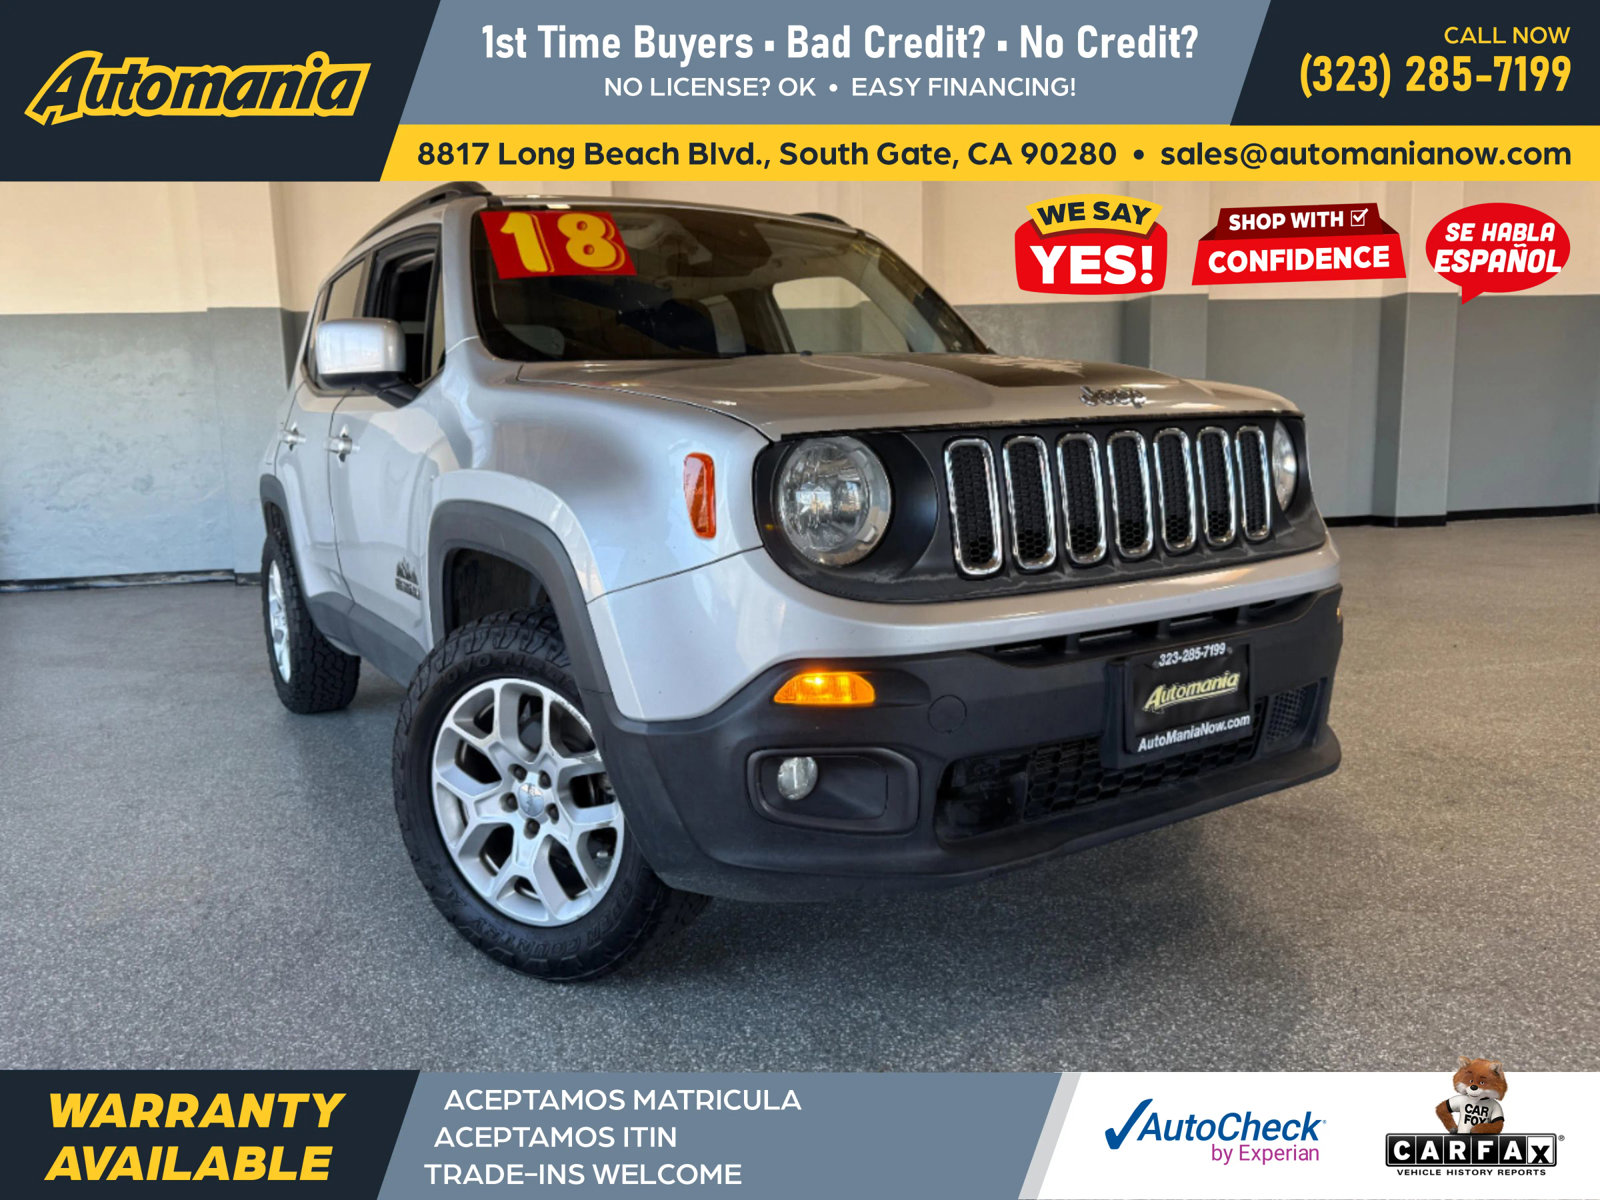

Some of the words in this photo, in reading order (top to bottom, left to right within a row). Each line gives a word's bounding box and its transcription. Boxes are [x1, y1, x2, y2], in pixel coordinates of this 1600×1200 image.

[500, 212, 626, 273] 18
[1158, 641, 1227, 667] 323-285-7199
[1141, 670, 1241, 715] Automania
[1137, 713, 1251, 753] AutoManiaNow.com
